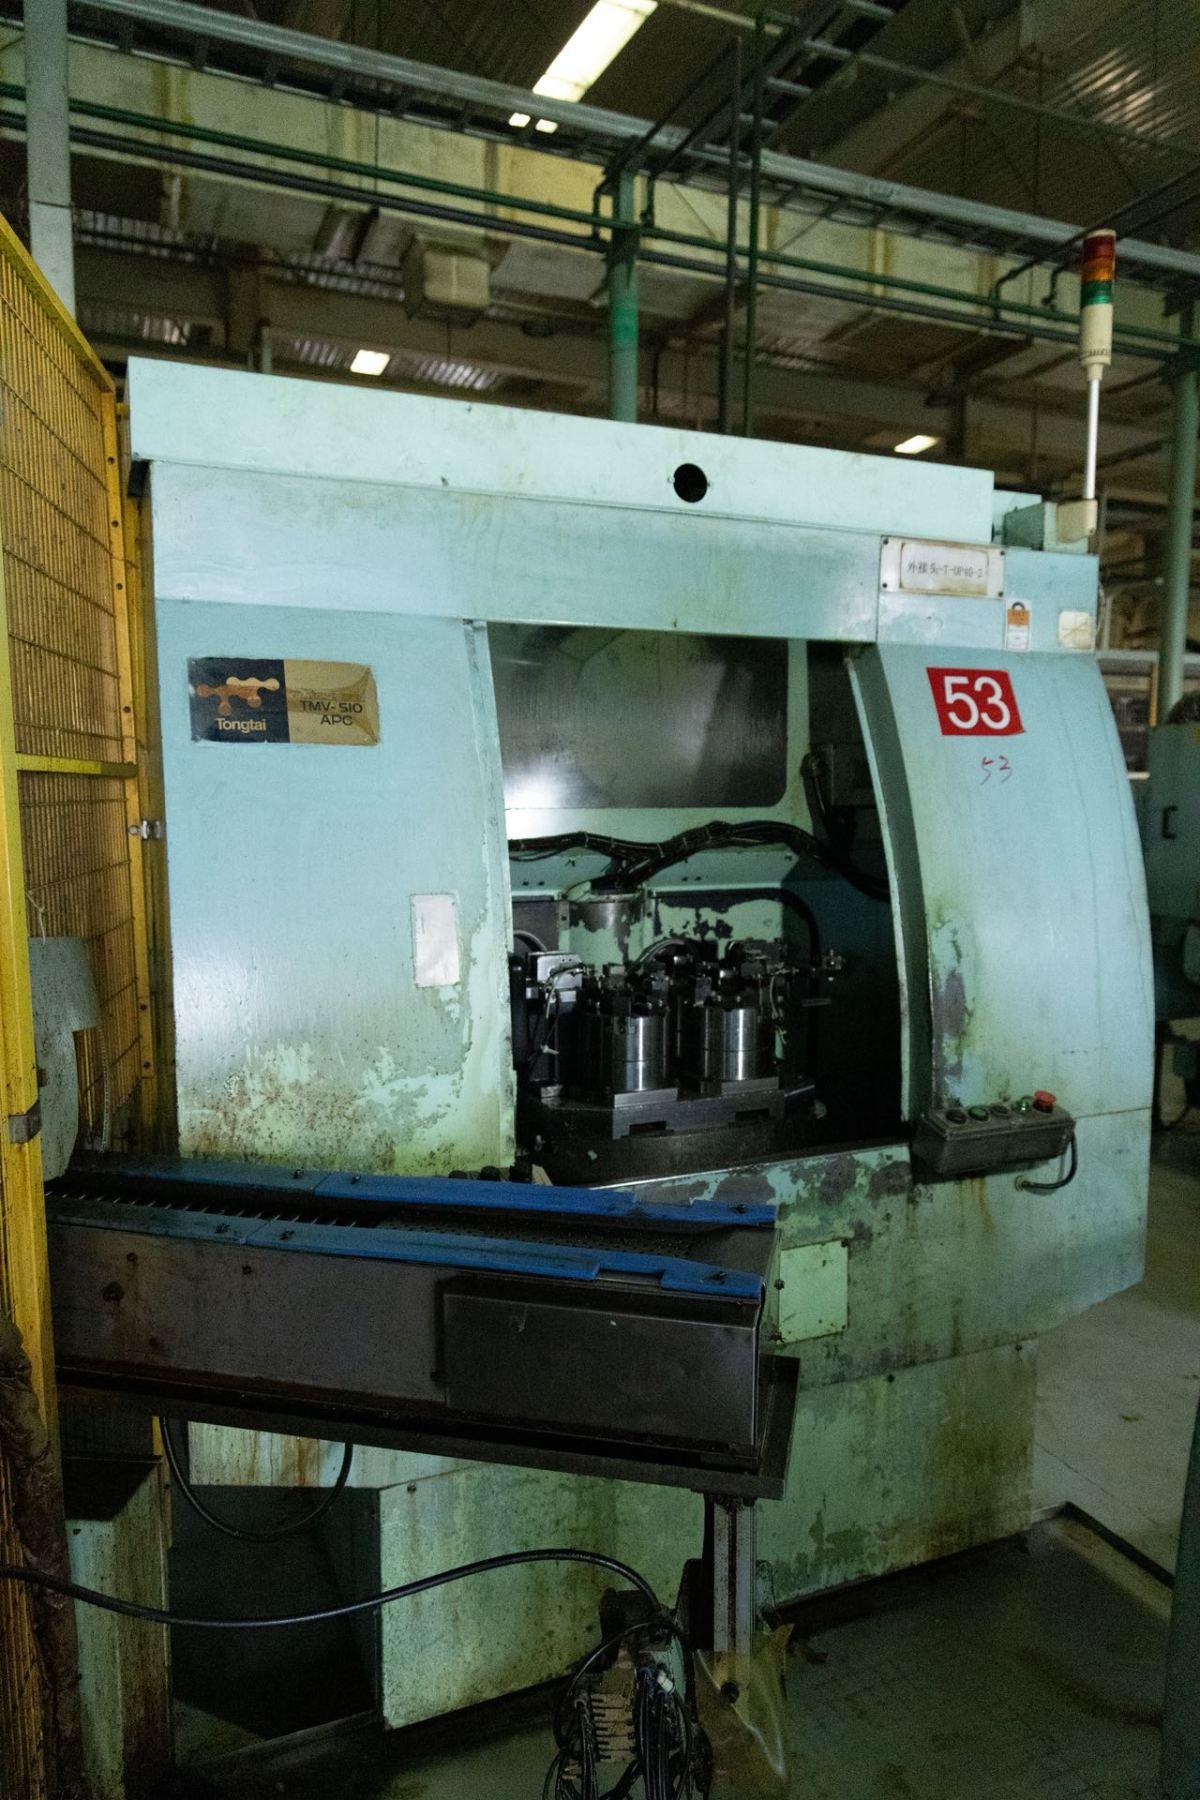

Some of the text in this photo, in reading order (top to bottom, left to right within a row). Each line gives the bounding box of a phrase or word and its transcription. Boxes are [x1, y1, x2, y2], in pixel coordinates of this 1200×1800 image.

[944, 676, 1010, 729] 53
[215, 717, 266, 733] Tongtai
[320, 714, 353, 726] APC
[979, 755, 1013, 786] 53
